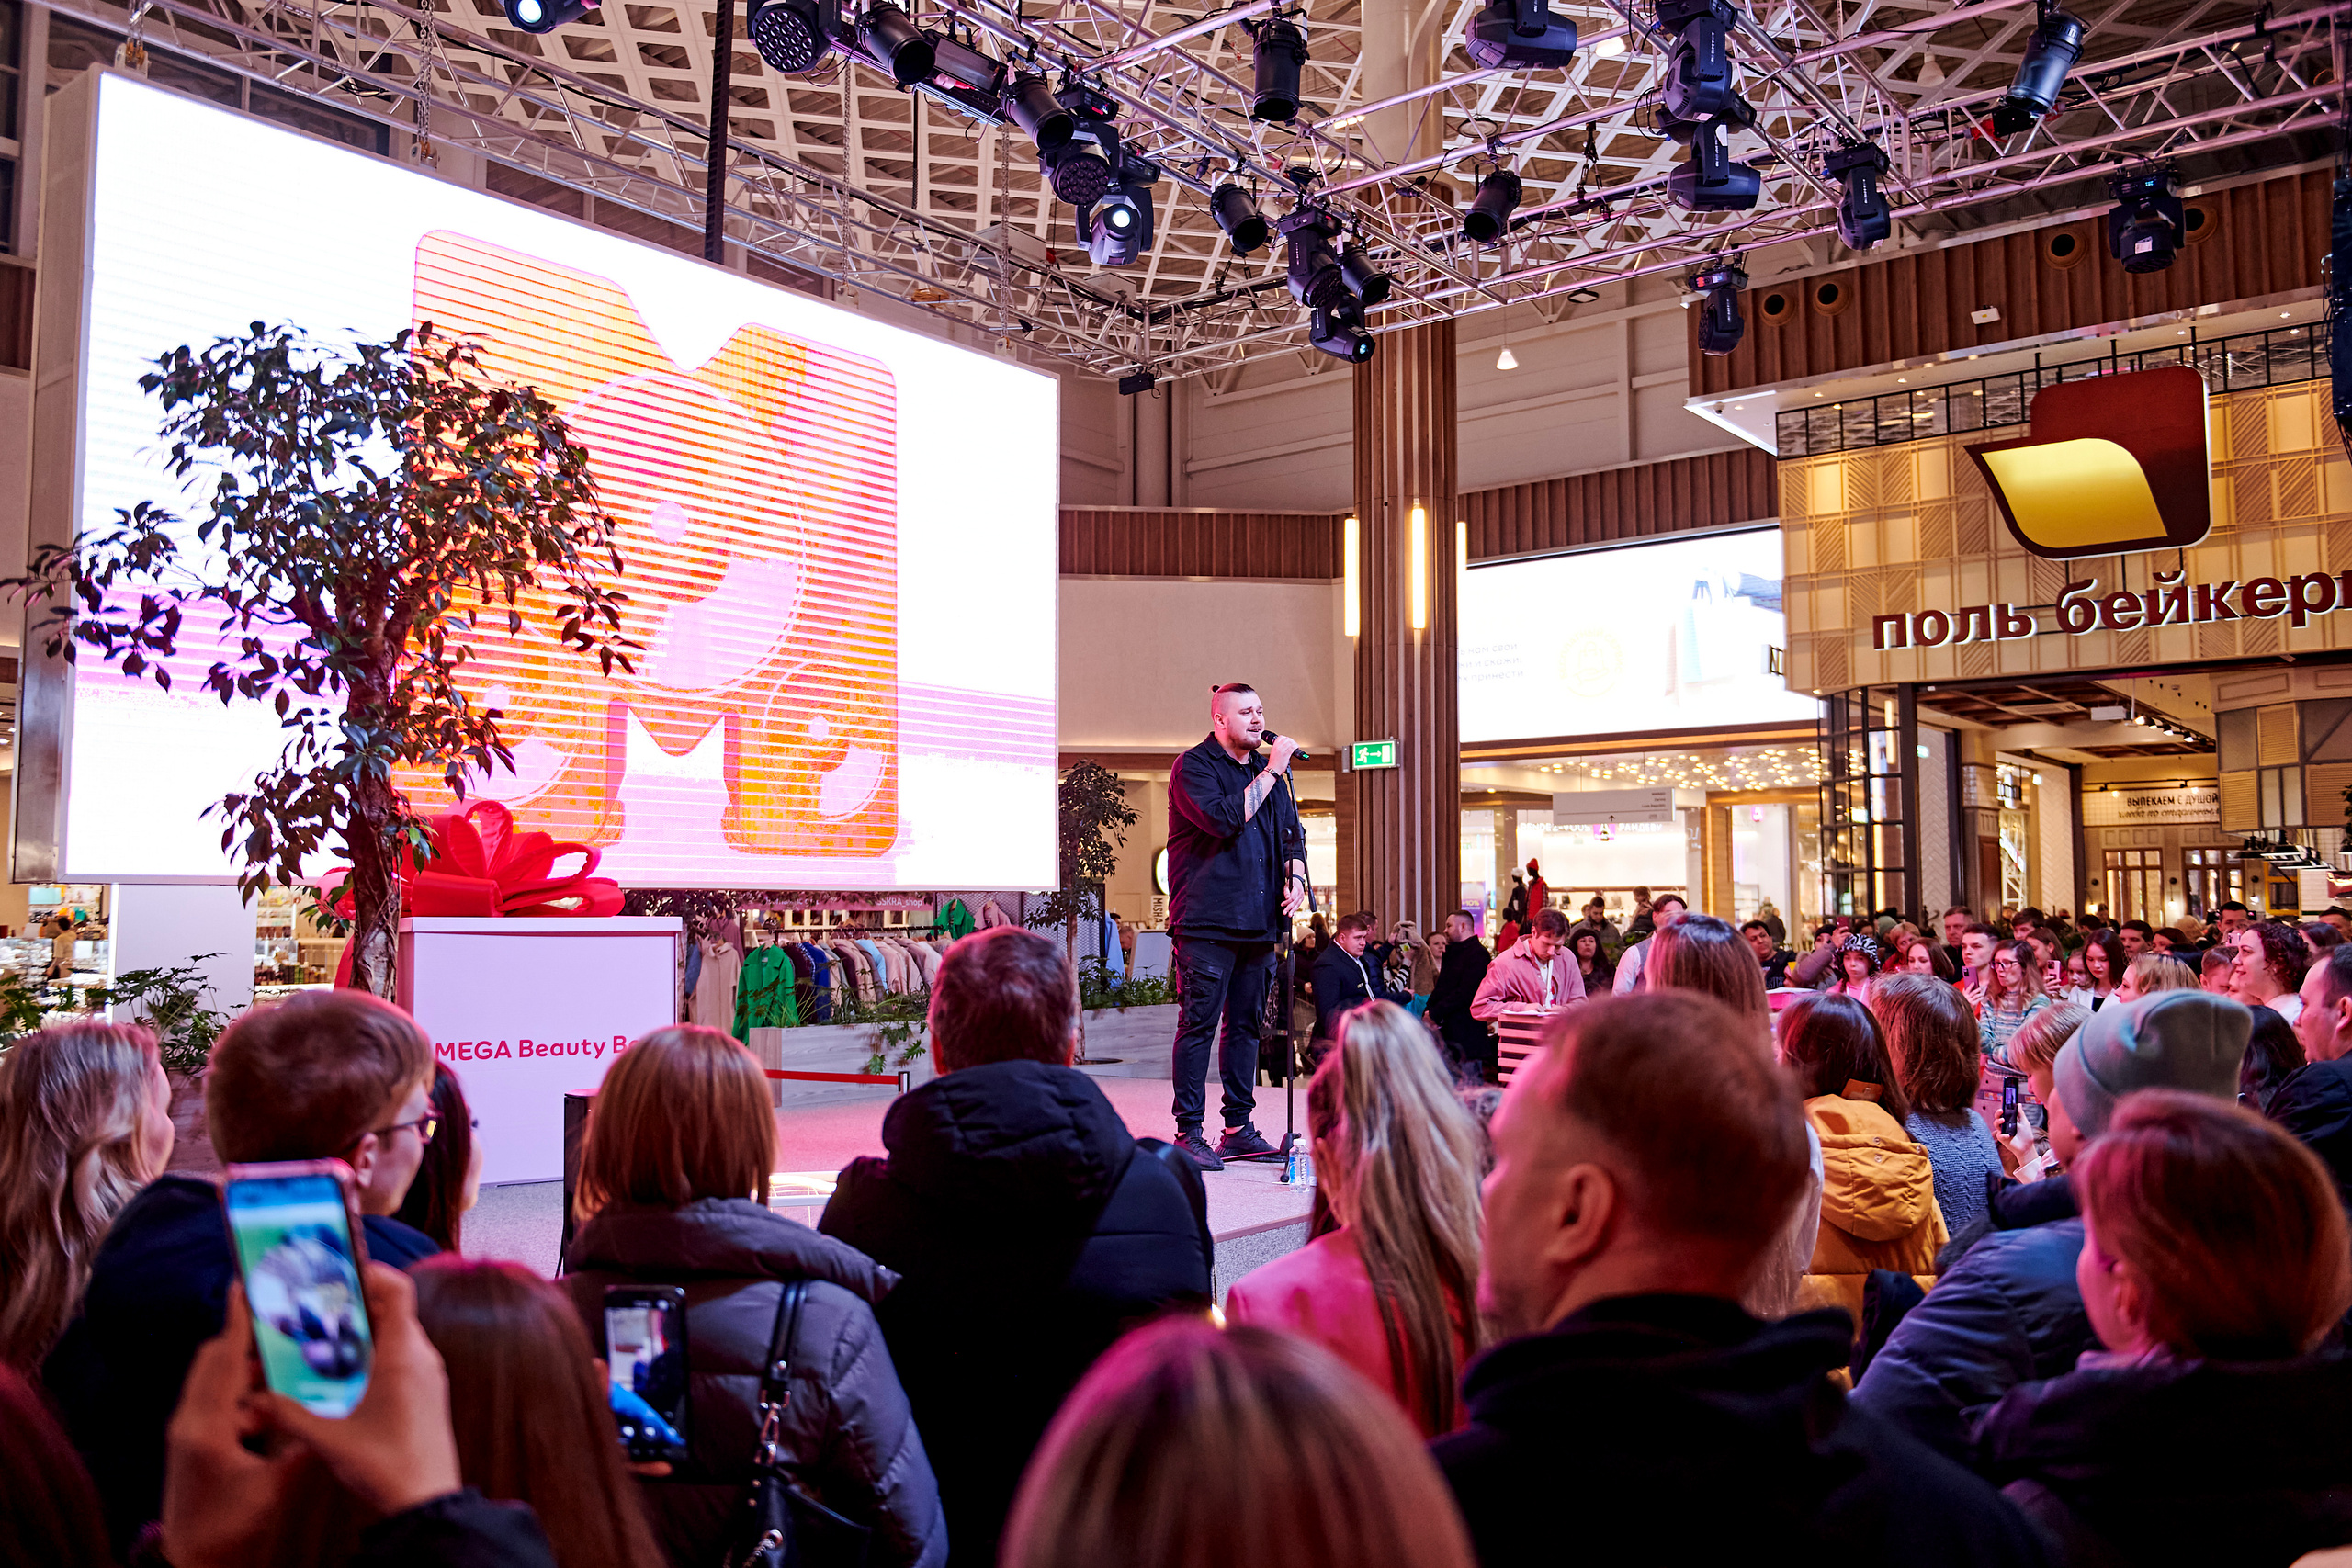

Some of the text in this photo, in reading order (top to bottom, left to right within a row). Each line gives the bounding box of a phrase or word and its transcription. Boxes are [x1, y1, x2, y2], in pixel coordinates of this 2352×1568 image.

[1872, 603, 2038, 650] поль
[2127, 796, 2175, 807] ВЫПЕКАЕМ
[2186, 793, 2219, 806] ДУШОЙ
[1152, 897, 1163, 923] MISHA
[435, 1040, 512, 1061] MEGA
[518, 1039, 606, 1059] Beauty
